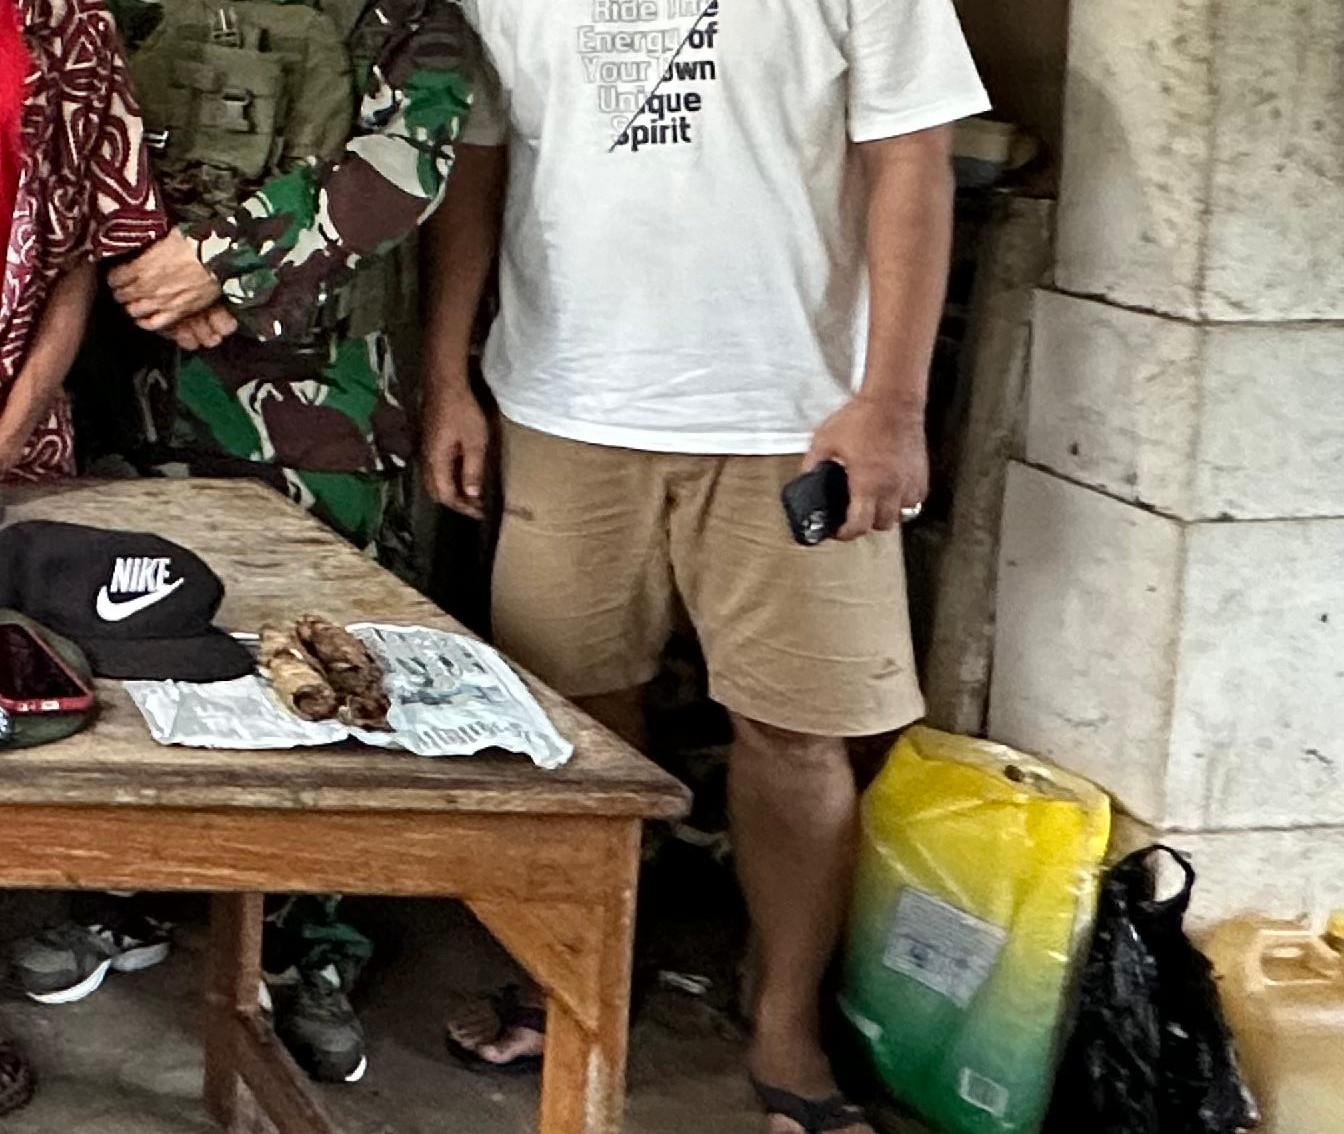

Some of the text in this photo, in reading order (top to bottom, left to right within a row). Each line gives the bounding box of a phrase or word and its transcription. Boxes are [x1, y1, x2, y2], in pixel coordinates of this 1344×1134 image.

[577, 20, 719, 54] Energy of
[581, 55, 716, 83] Your Own
[598, 84, 702, 121] Unique
[611, 115, 692, 153] Spirit
[109, 555, 172, 594] NIKE
